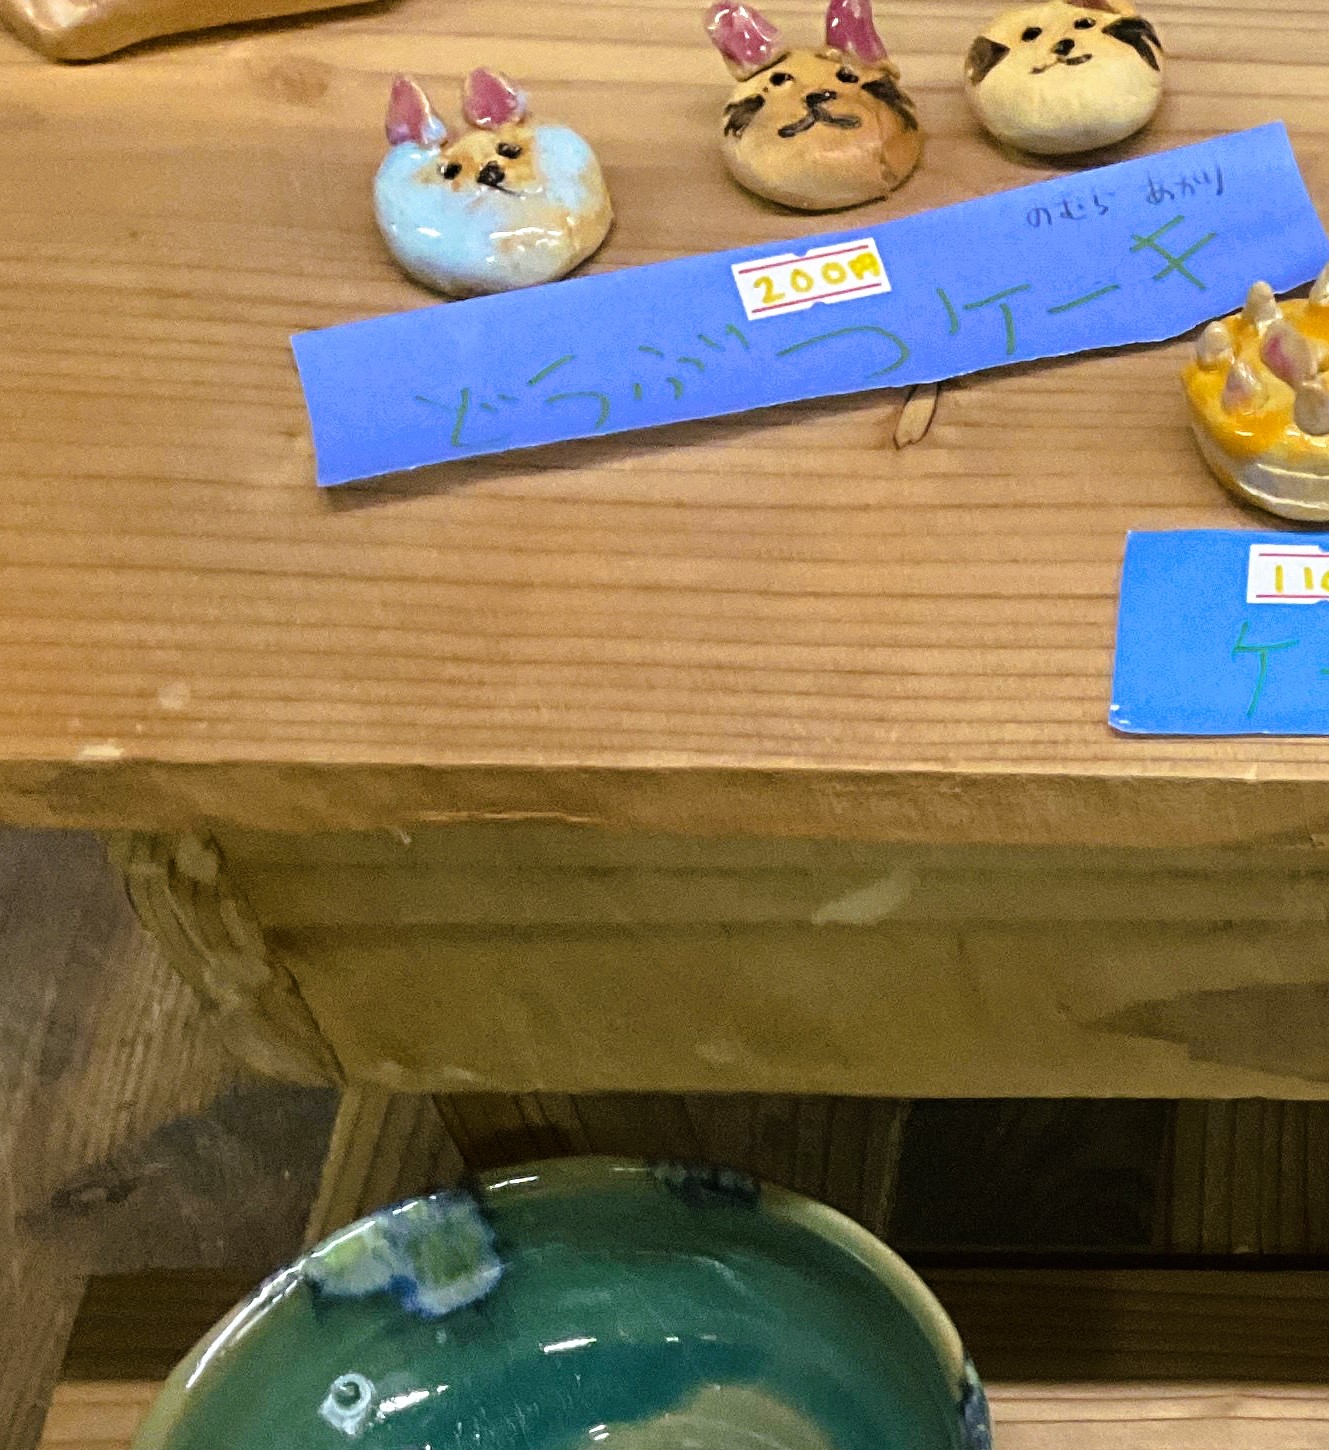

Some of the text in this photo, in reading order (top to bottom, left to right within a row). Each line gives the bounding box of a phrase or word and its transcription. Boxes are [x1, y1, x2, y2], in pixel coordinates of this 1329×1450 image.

[1026, 163, 1225, 227] のむら あかり
[752, 252, 883, 304] 200円
